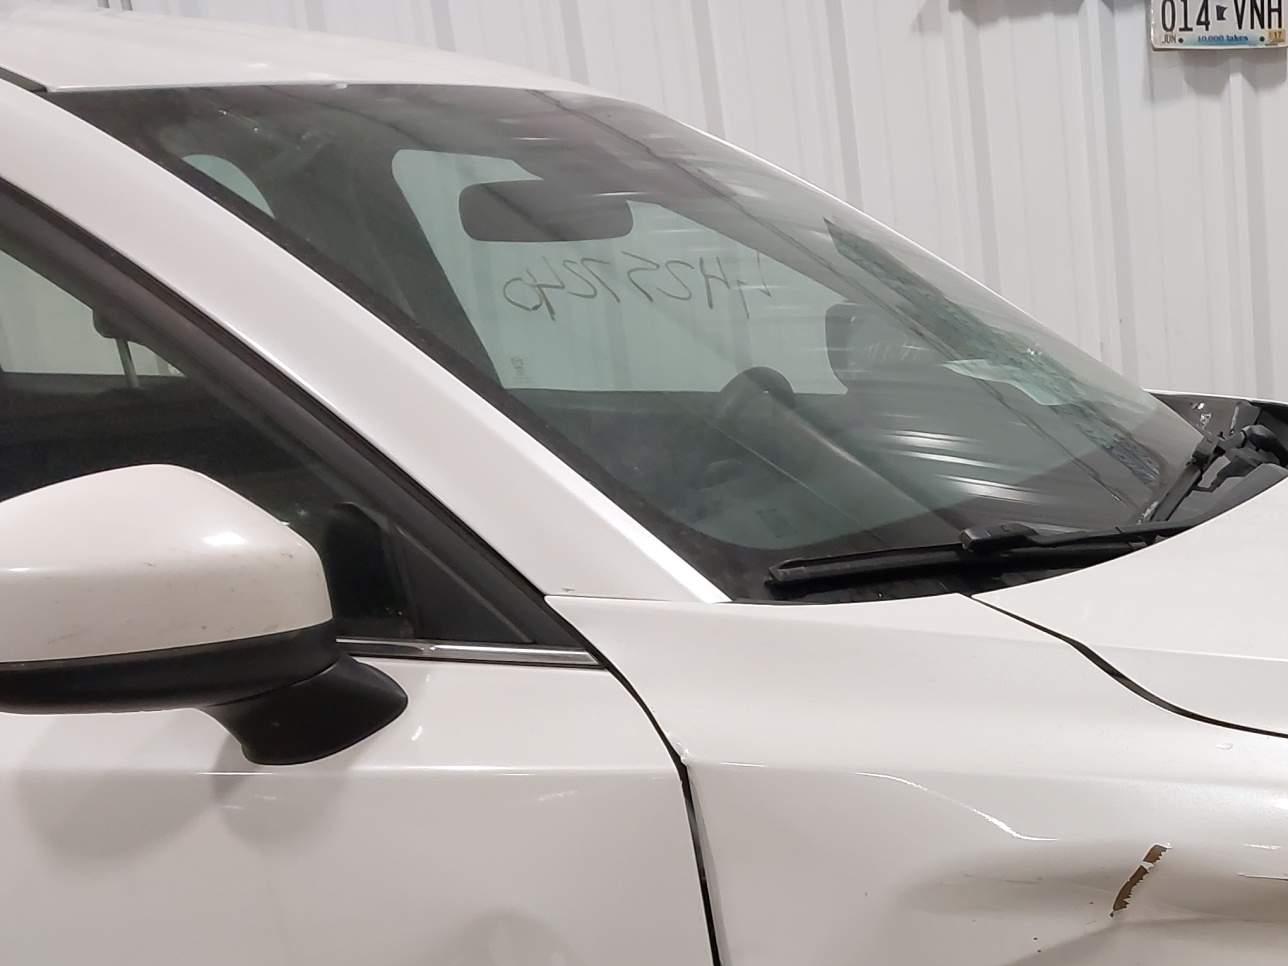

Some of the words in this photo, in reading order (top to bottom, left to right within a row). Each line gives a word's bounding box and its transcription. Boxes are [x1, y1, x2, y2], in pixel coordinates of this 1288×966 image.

[1160, 0, 1211, 32] 014
[1234, 0, 1282, 29] VNH
[1162, 34, 1177, 44] JUN
